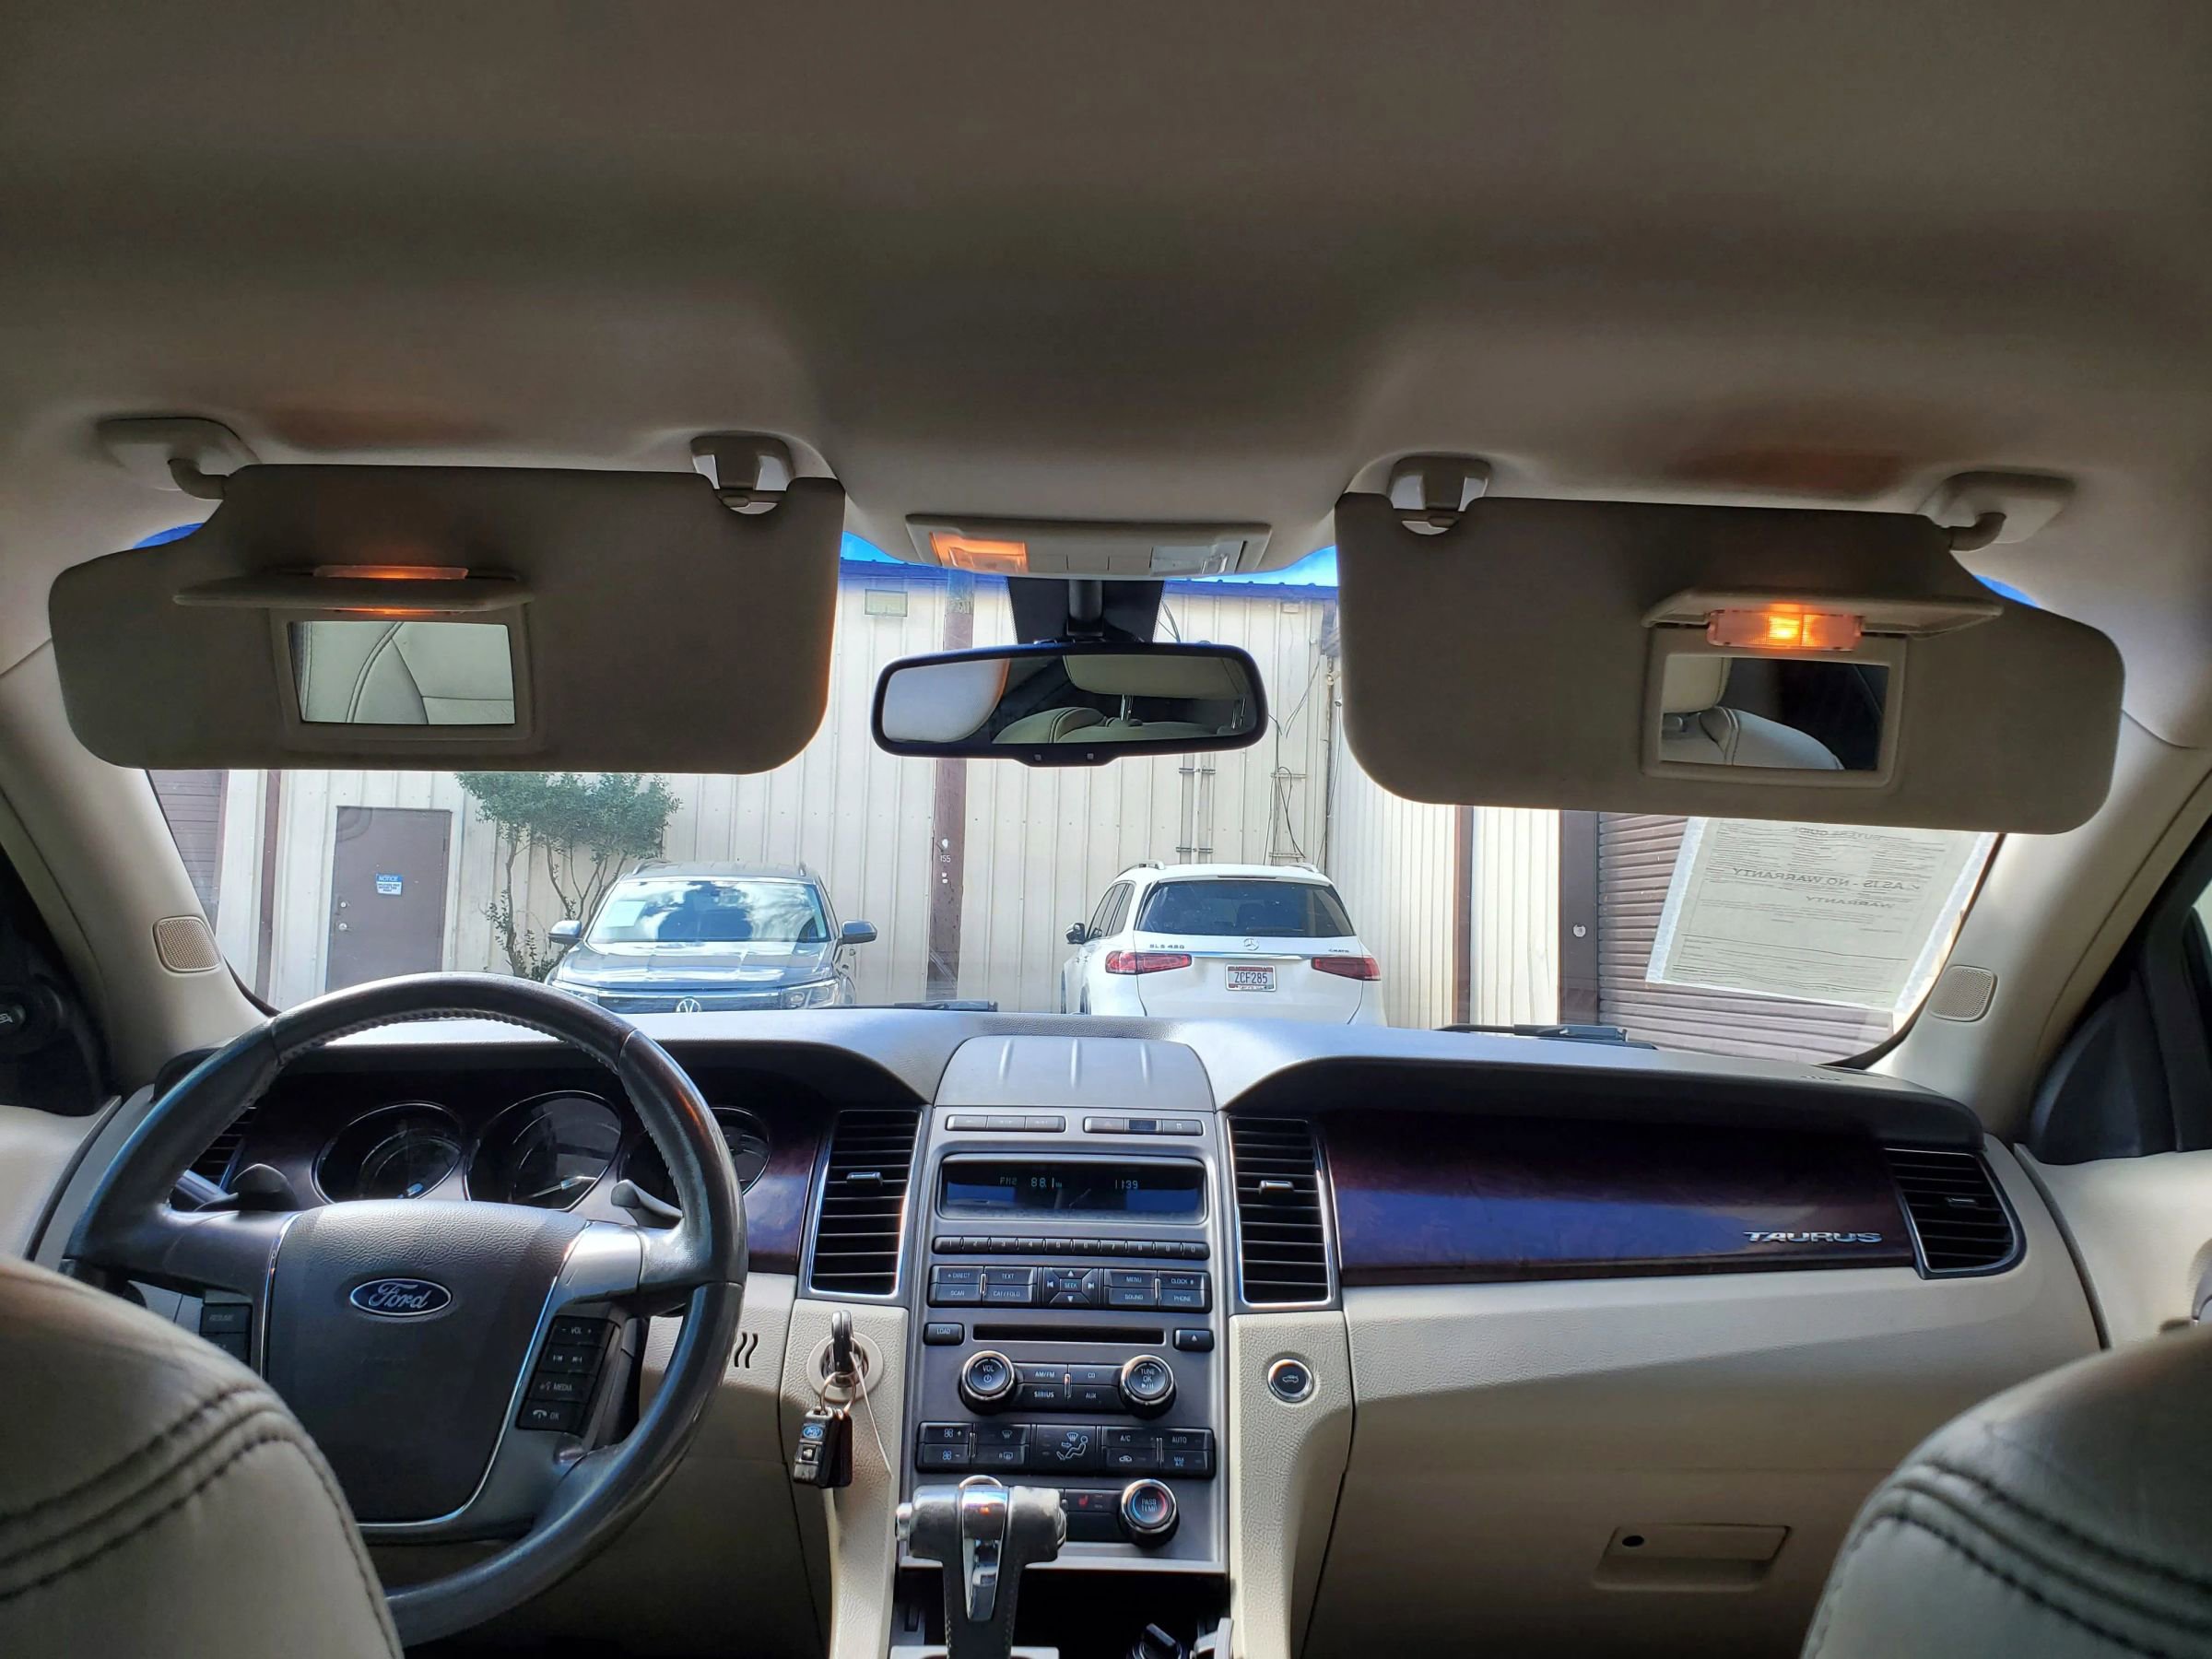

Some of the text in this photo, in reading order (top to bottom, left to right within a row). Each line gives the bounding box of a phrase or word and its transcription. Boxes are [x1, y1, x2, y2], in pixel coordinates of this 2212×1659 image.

[1234, 971, 1268, 984] ZCF285
[1743, 1231, 1883, 1243] TAURUS
[369, 1282, 431, 1309] Ford
[982, 1364, 994, 1372] VOL
[553, 1383, 572, 1392] MEDIA
